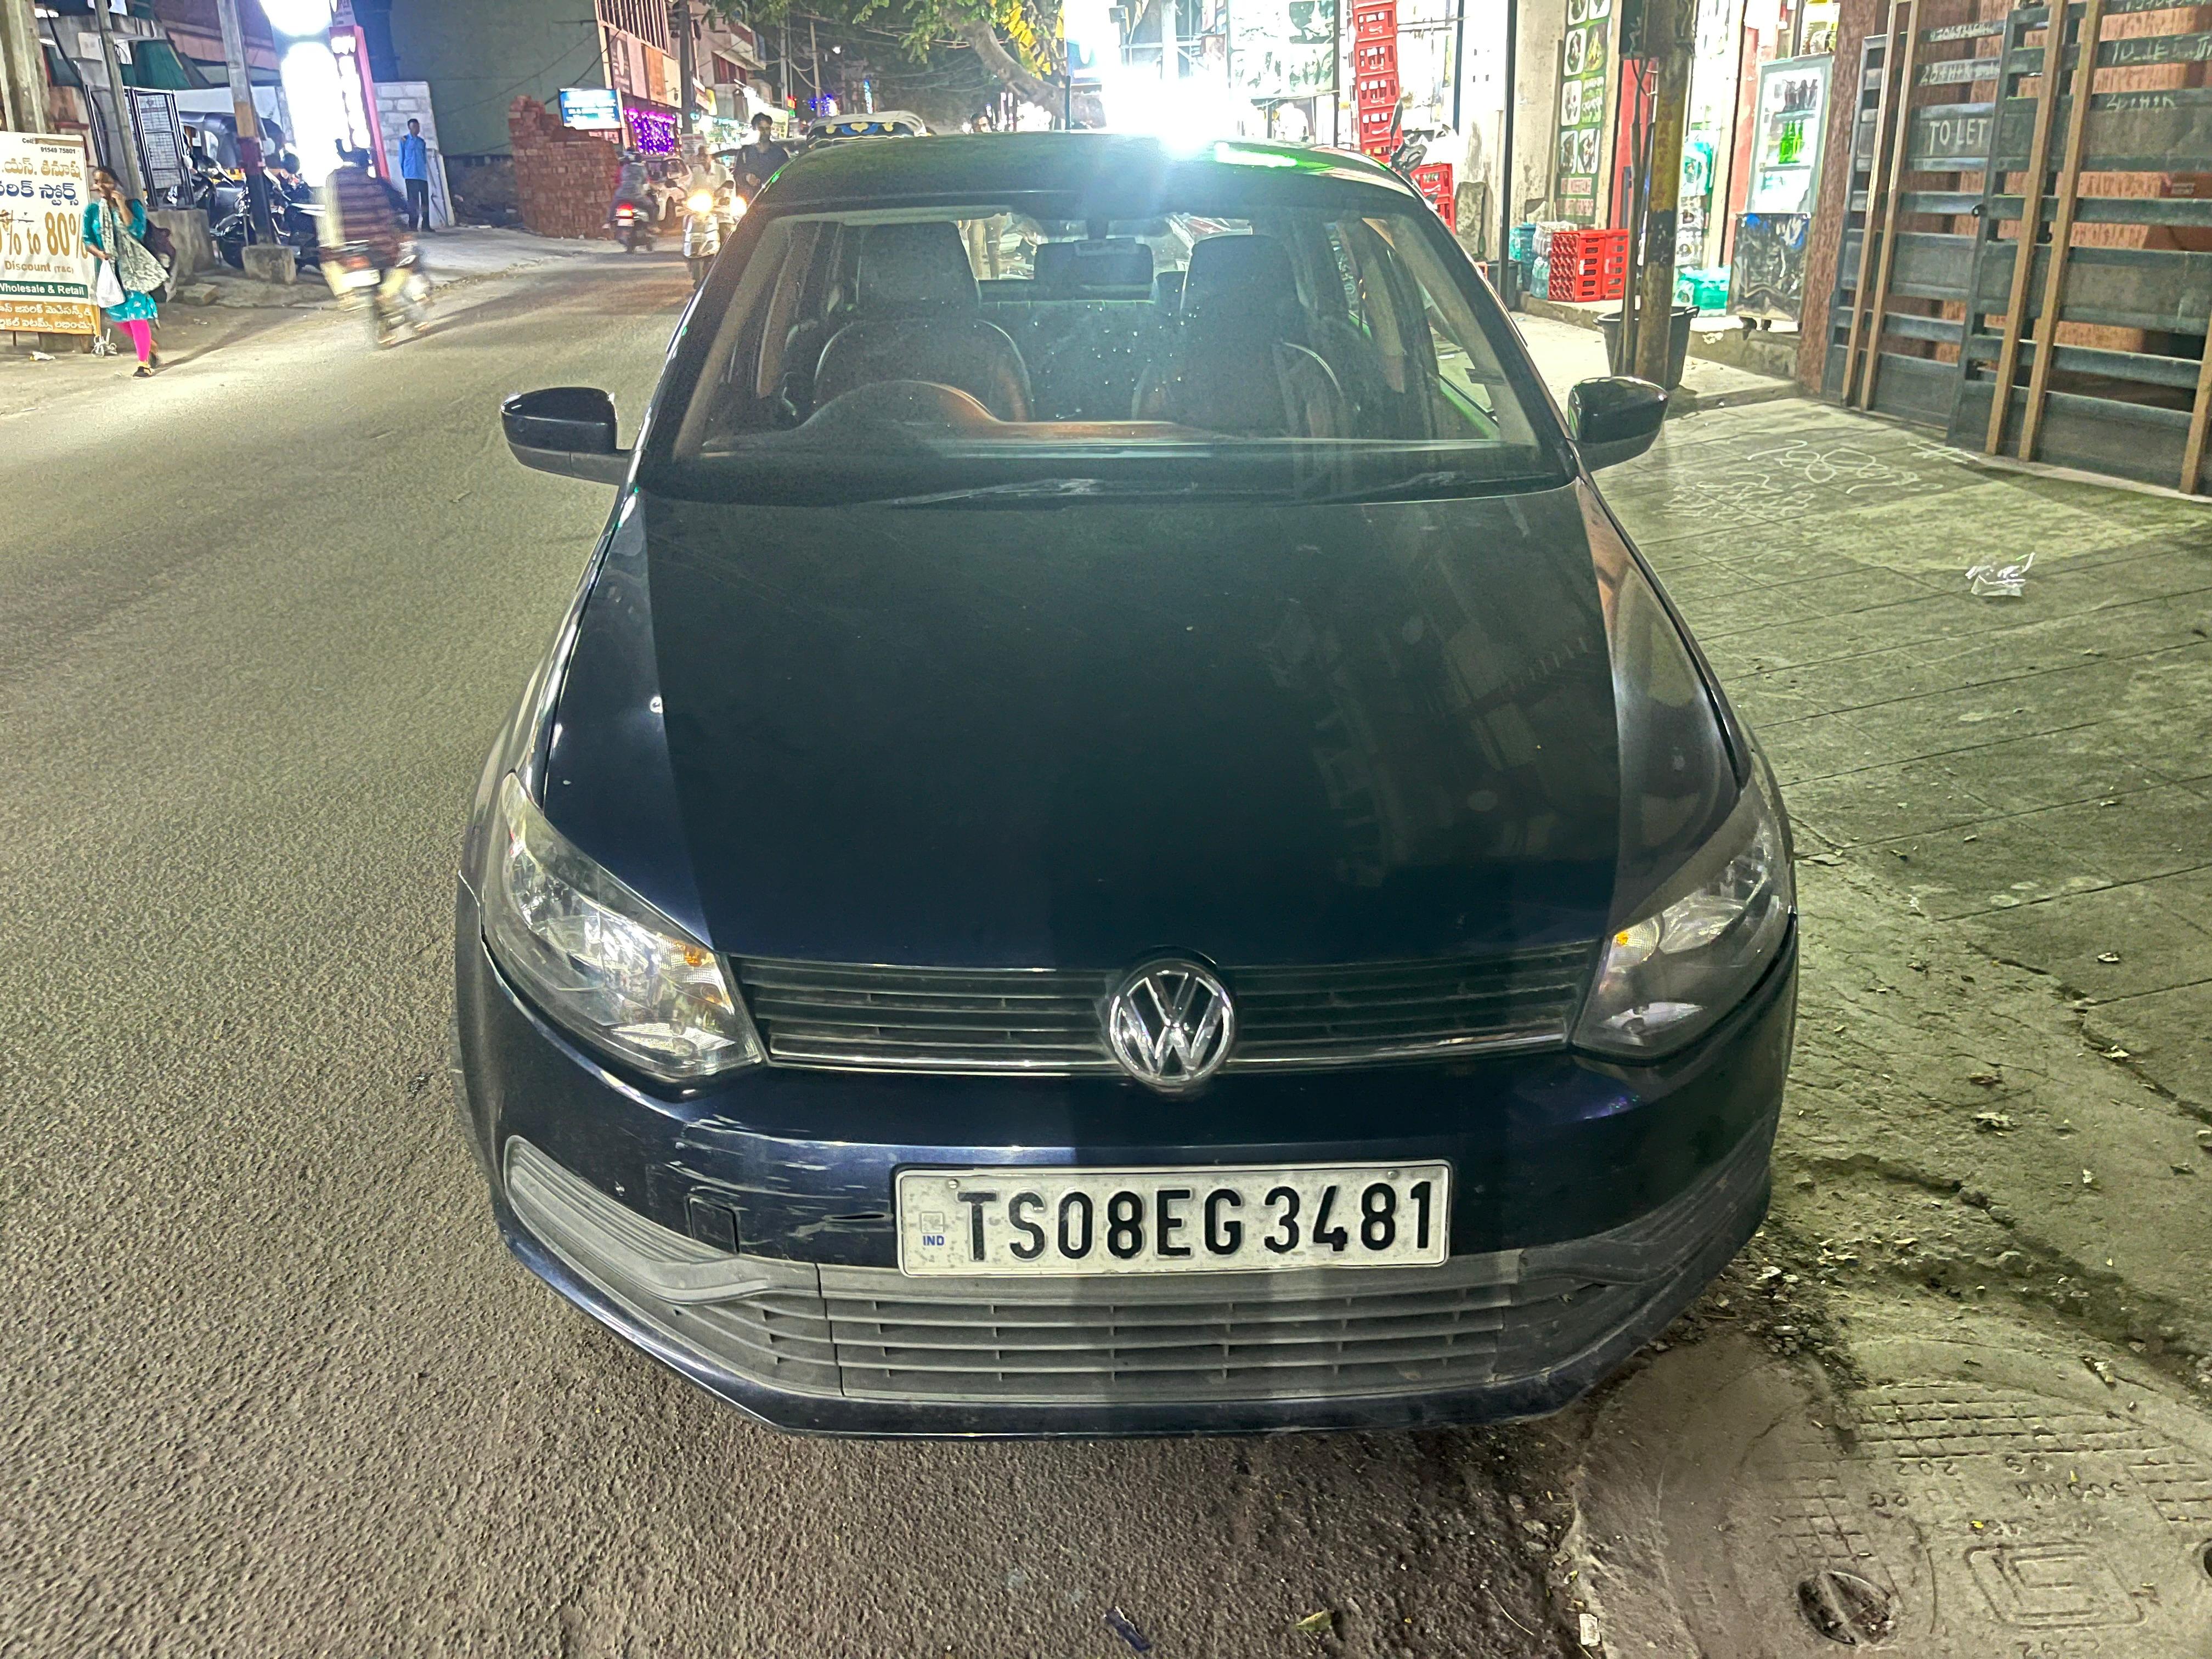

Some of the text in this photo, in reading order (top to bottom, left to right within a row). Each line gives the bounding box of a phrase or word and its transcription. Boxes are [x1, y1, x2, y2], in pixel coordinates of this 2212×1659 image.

[1929, 116, 1987, 155] TO LET
[27, 227, 41, 255] to
[45, 212, 88, 259] 80%
[4, 261, 51, 272] Discount
[48, 285, 55, 294] &
[58, 285, 84, 295] Retail
[923, 1235, 944, 1246] IND
